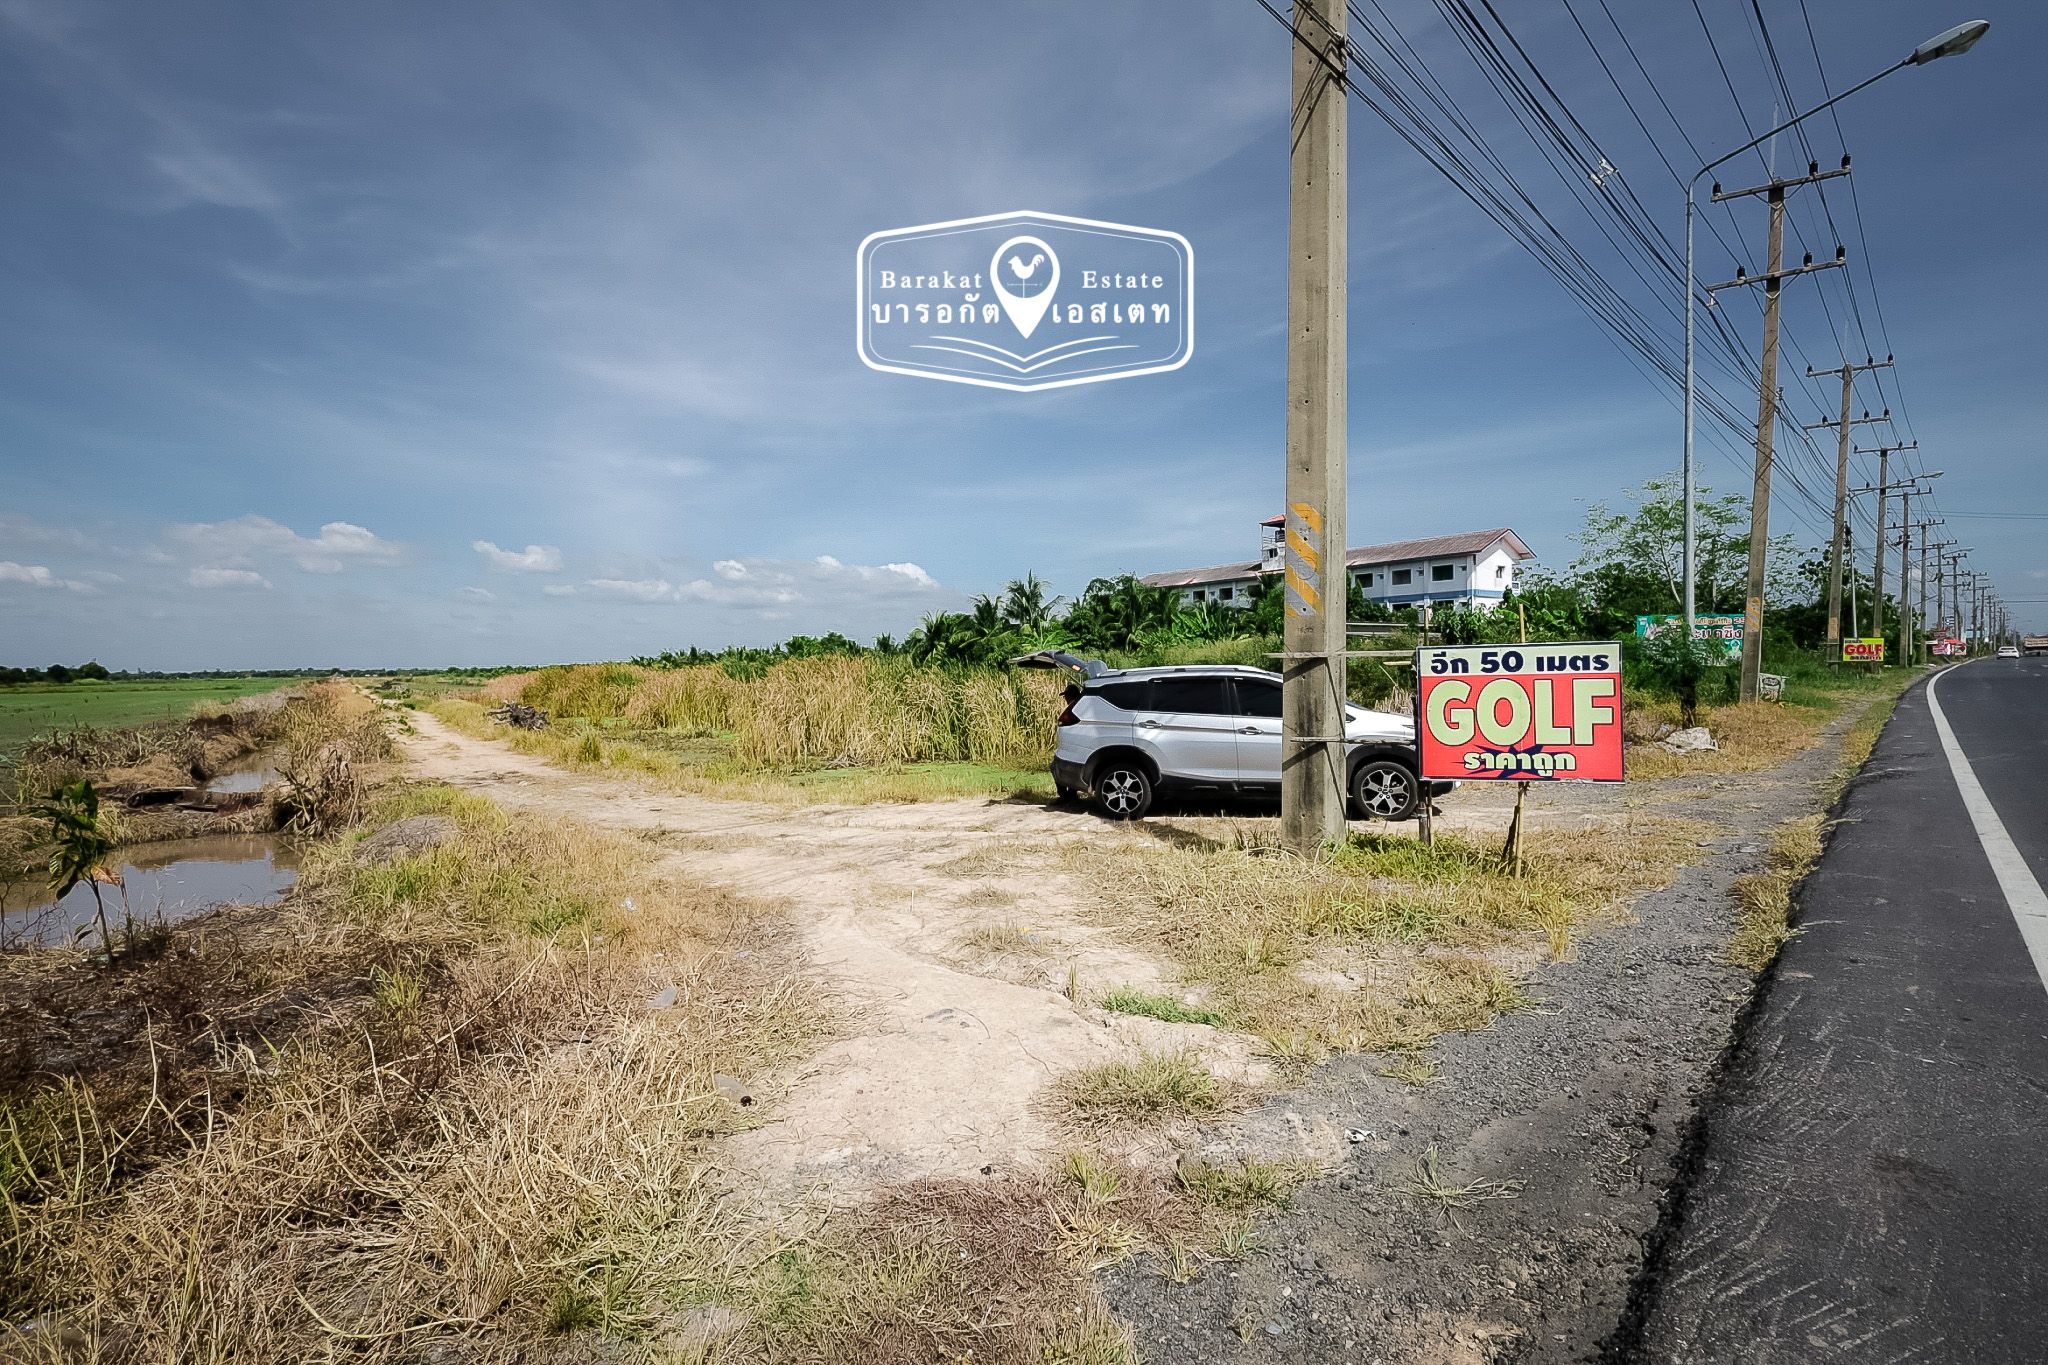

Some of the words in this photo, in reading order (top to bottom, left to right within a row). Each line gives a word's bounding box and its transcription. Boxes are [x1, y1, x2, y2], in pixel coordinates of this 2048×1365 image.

[1431, 651, 1469, 674] อีก
[1480, 650, 1524, 673] 50
[1536, 654, 1609, 672] เมตร
[1844, 643, 1883, 656] GOLF
[1426, 678, 1615, 746] GOLF
[1463, 751, 1577, 778] ราคาถูก
